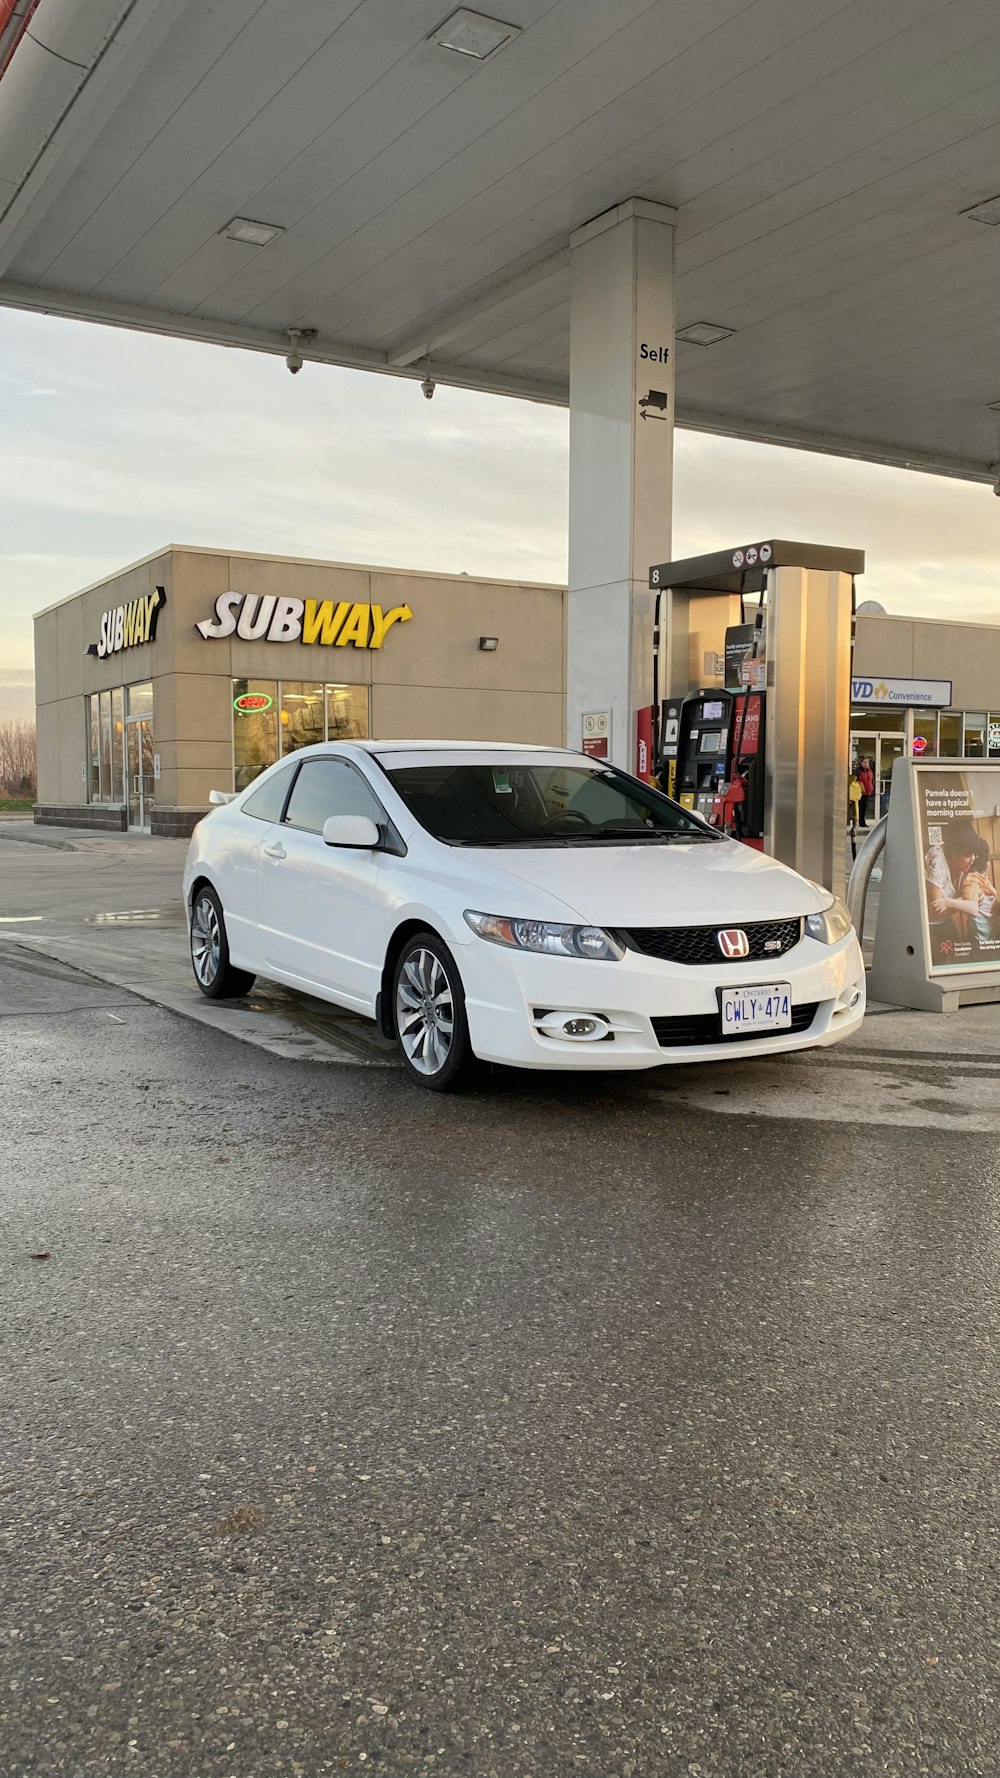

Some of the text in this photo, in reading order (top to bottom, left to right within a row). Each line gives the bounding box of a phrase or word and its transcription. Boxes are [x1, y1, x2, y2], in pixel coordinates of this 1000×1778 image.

[640, 343, 669, 364] Self
[652, 569, 660, 583] 8
[84, 586, 167, 659] SUBWAY
[195, 591, 413, 649] SUBWAY
[888, 690, 932, 701] Convenience
[238, 697, 267, 708] OPEN
[925, 789, 974, 797] Pamela doesn't
[925, 799, 942, 807] have
[947, 799, 969, 808] typical
[926, 808, 954, 818] morning
[743, 988, 771, 998] ONTARIO
[725, 996, 789, 1022] CWLY 474
